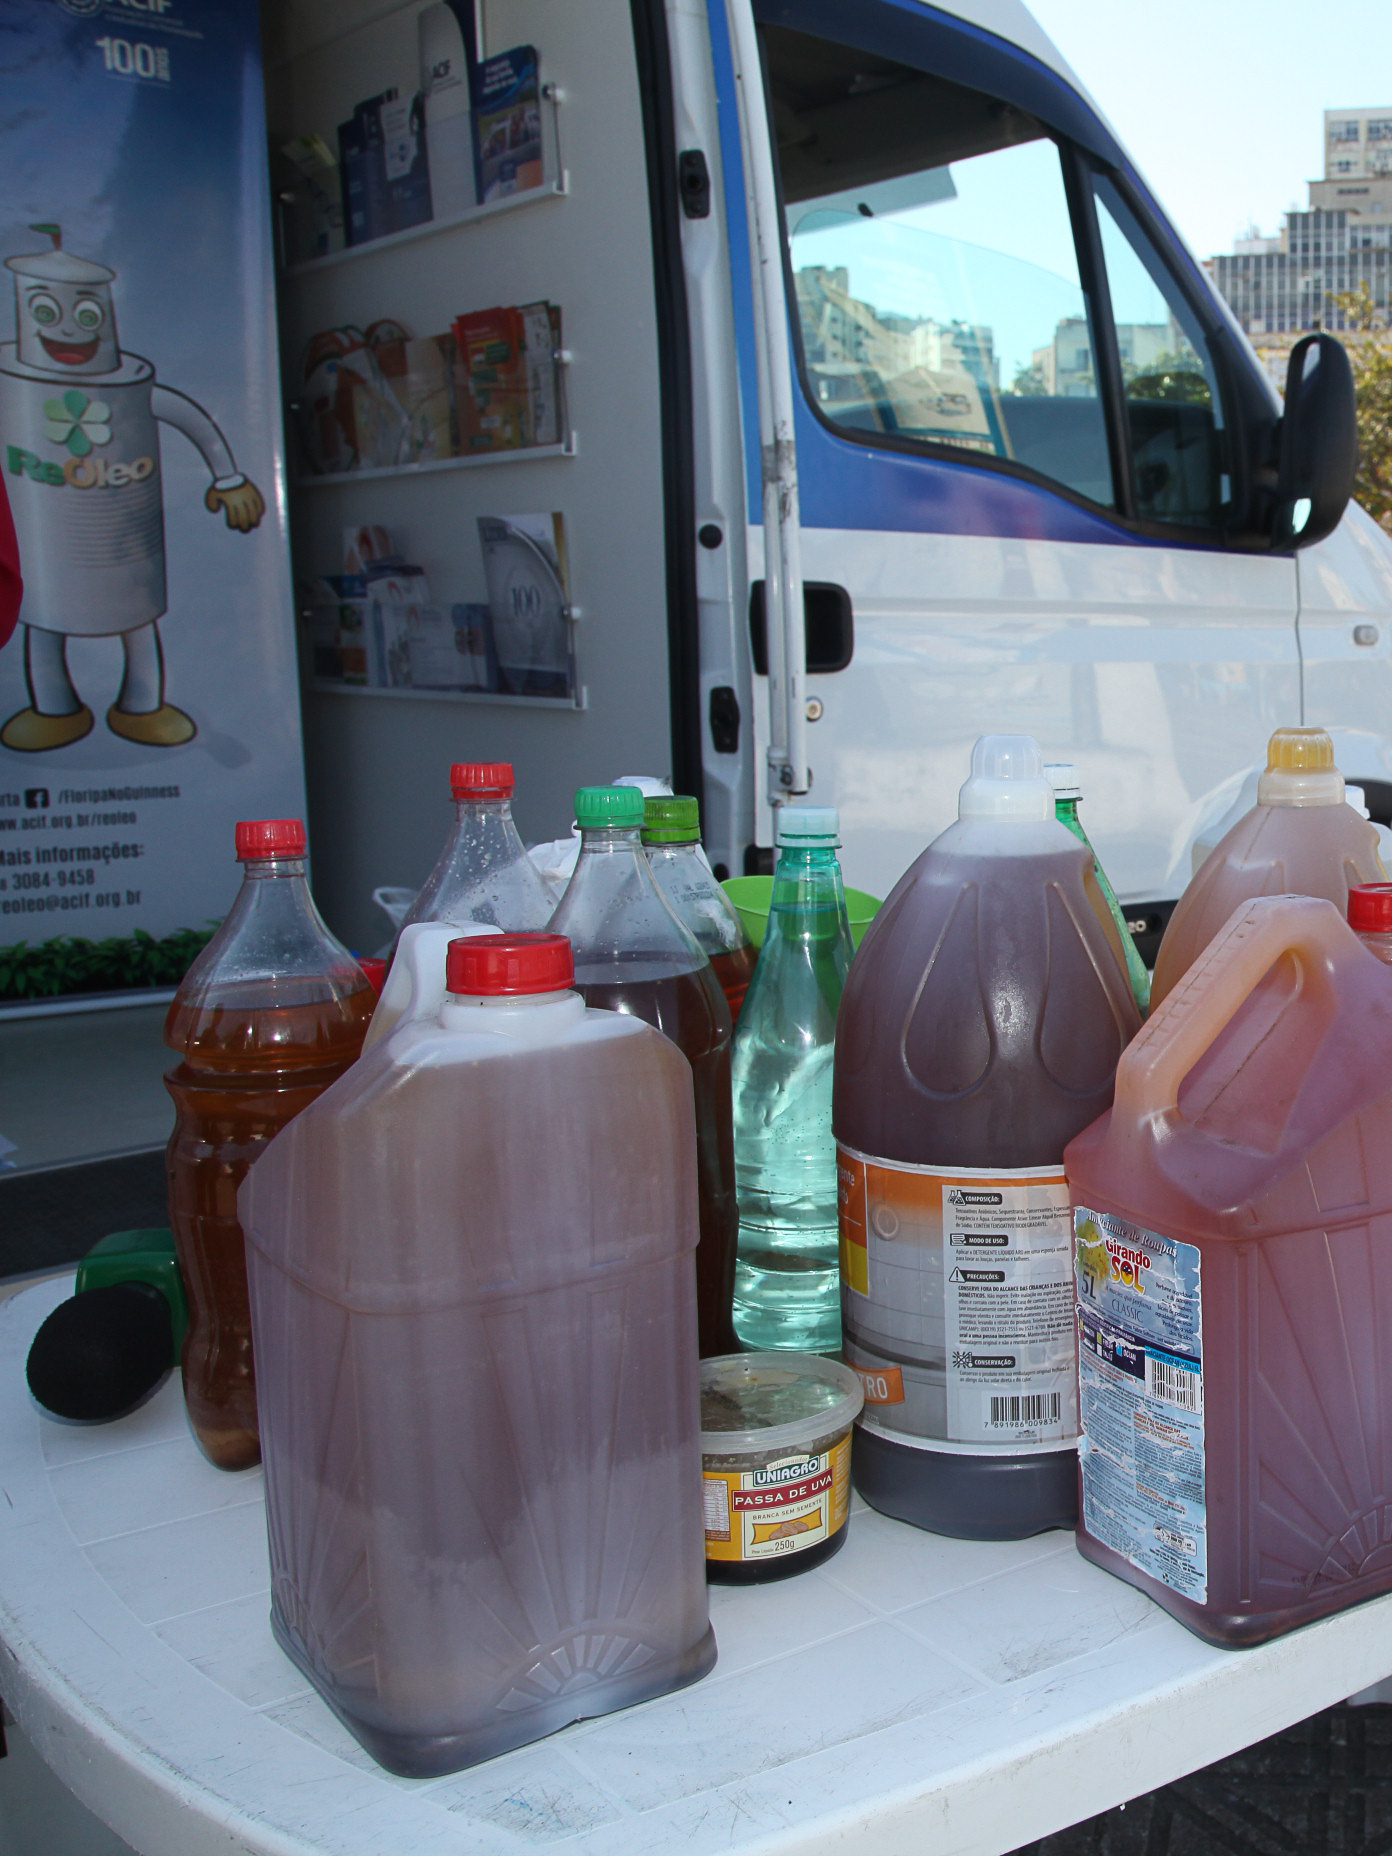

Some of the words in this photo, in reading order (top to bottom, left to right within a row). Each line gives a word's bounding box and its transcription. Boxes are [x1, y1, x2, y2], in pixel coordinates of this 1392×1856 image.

[95, 36, 156, 78] 100
[6, 444, 154, 489] ReOleo
[0, 811, 137, 831] ww.acif.org.br/reoleo
[36, 842, 145, 865] informações:
[12, 868, 95, 890] 3084-9458
[2, 890, 142, 915] eoleo@acif.org.br
[965, 1195, 1000, 1203] COMPOSIÇÃO:
[1105, 1238, 1151, 1269] Girando
[1128, 1229, 1140, 1243] de
[1141, 1234, 1177, 1258] Roupas
[966, 1273, 1000, 1281] PRECAUÇÕES:
[1081, 1270, 1097, 1300] 5L
[1111, 1255, 1146, 1295] SOL
[1111, 1298, 1143, 1323] CLASSIC
[974, 1358, 1013, 1366] CONSERVAÇÃO:
[1028, 1418, 1058, 1427] 009834
[756, 1459, 818, 1484] UNIAGRO
[735, 1493, 784, 1506] PASSA
[789, 1486, 807, 1499] DE
[811, 1475, 832, 1491] UVA
[752, 1512, 780, 1520] BRANCA
[781, 1508, 795, 1516] SEM
[796, 1498, 822, 1512] SEMENTE
[774, 1539, 795, 1551] 250g
